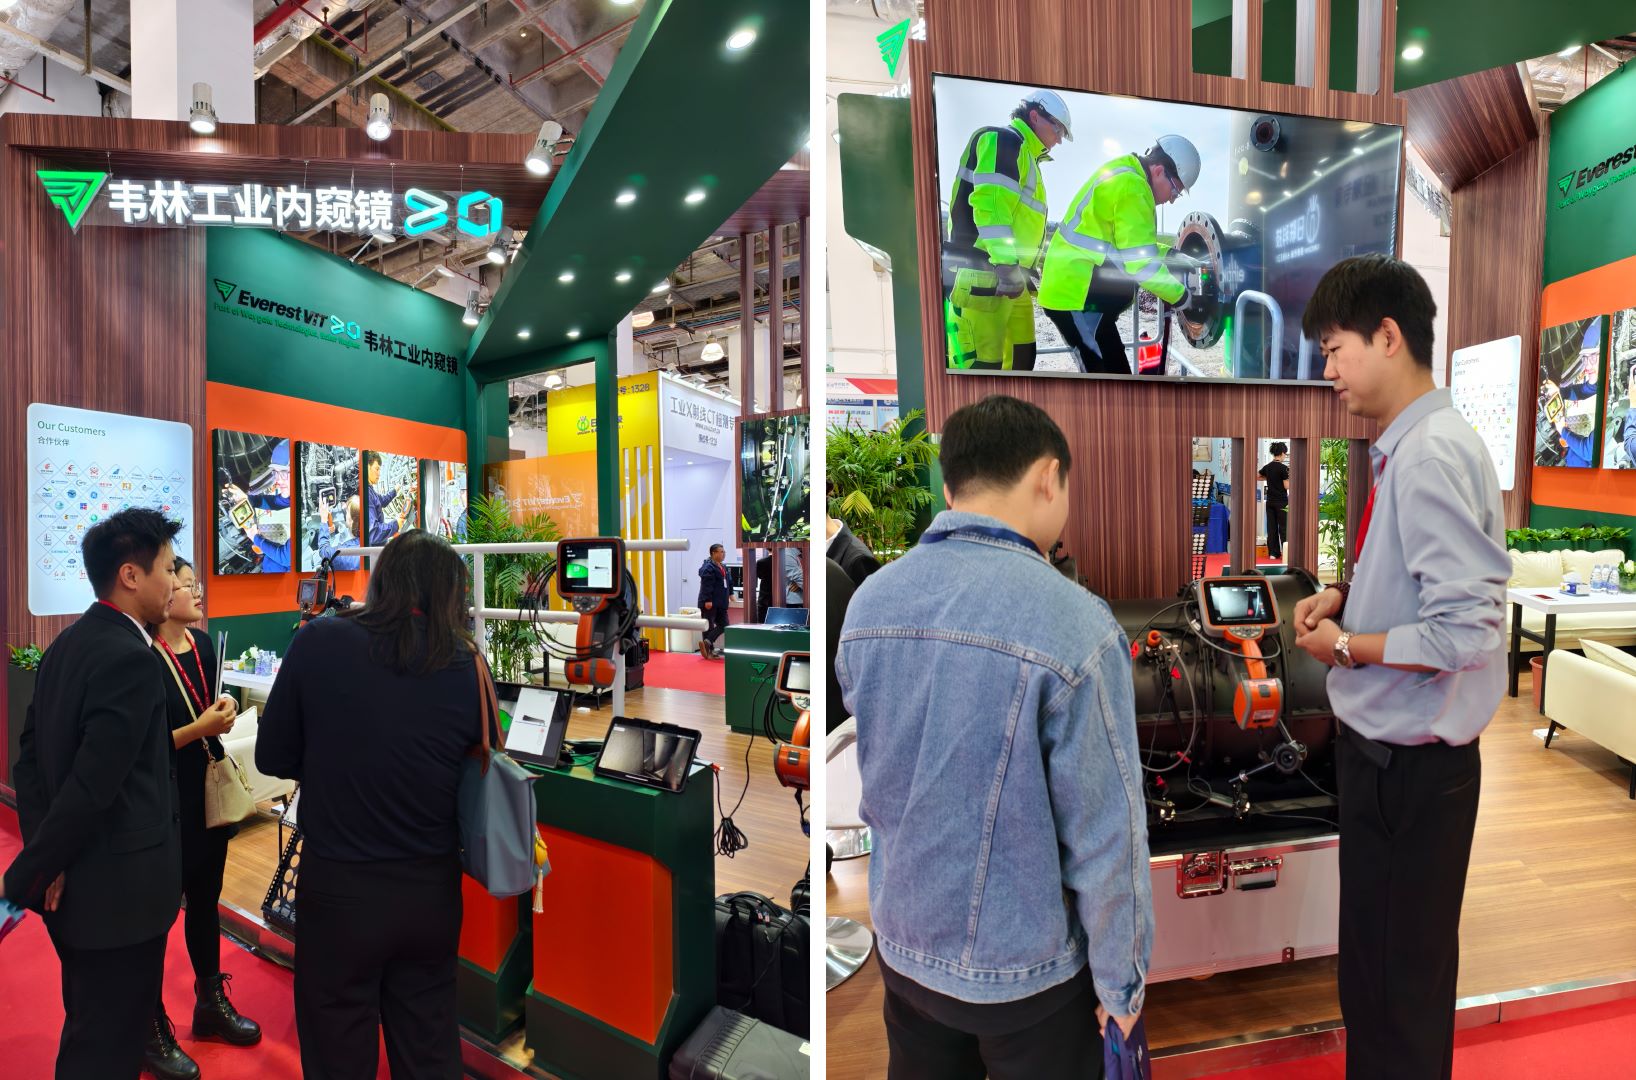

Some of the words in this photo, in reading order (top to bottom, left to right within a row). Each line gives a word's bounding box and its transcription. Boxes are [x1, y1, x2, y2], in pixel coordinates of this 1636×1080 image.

[1576, 145, 1636, 190] Everes
[109, 180, 394, 231] 韦林工业内窥镜
[238, 289, 302, 321] Everest
[364, 329, 459, 376] 韦林工业内窥镜
[37, 420, 56, 431] Our
[58, 422, 106, 437] Customers
[37, 435, 70, 447] 合作伙伴
